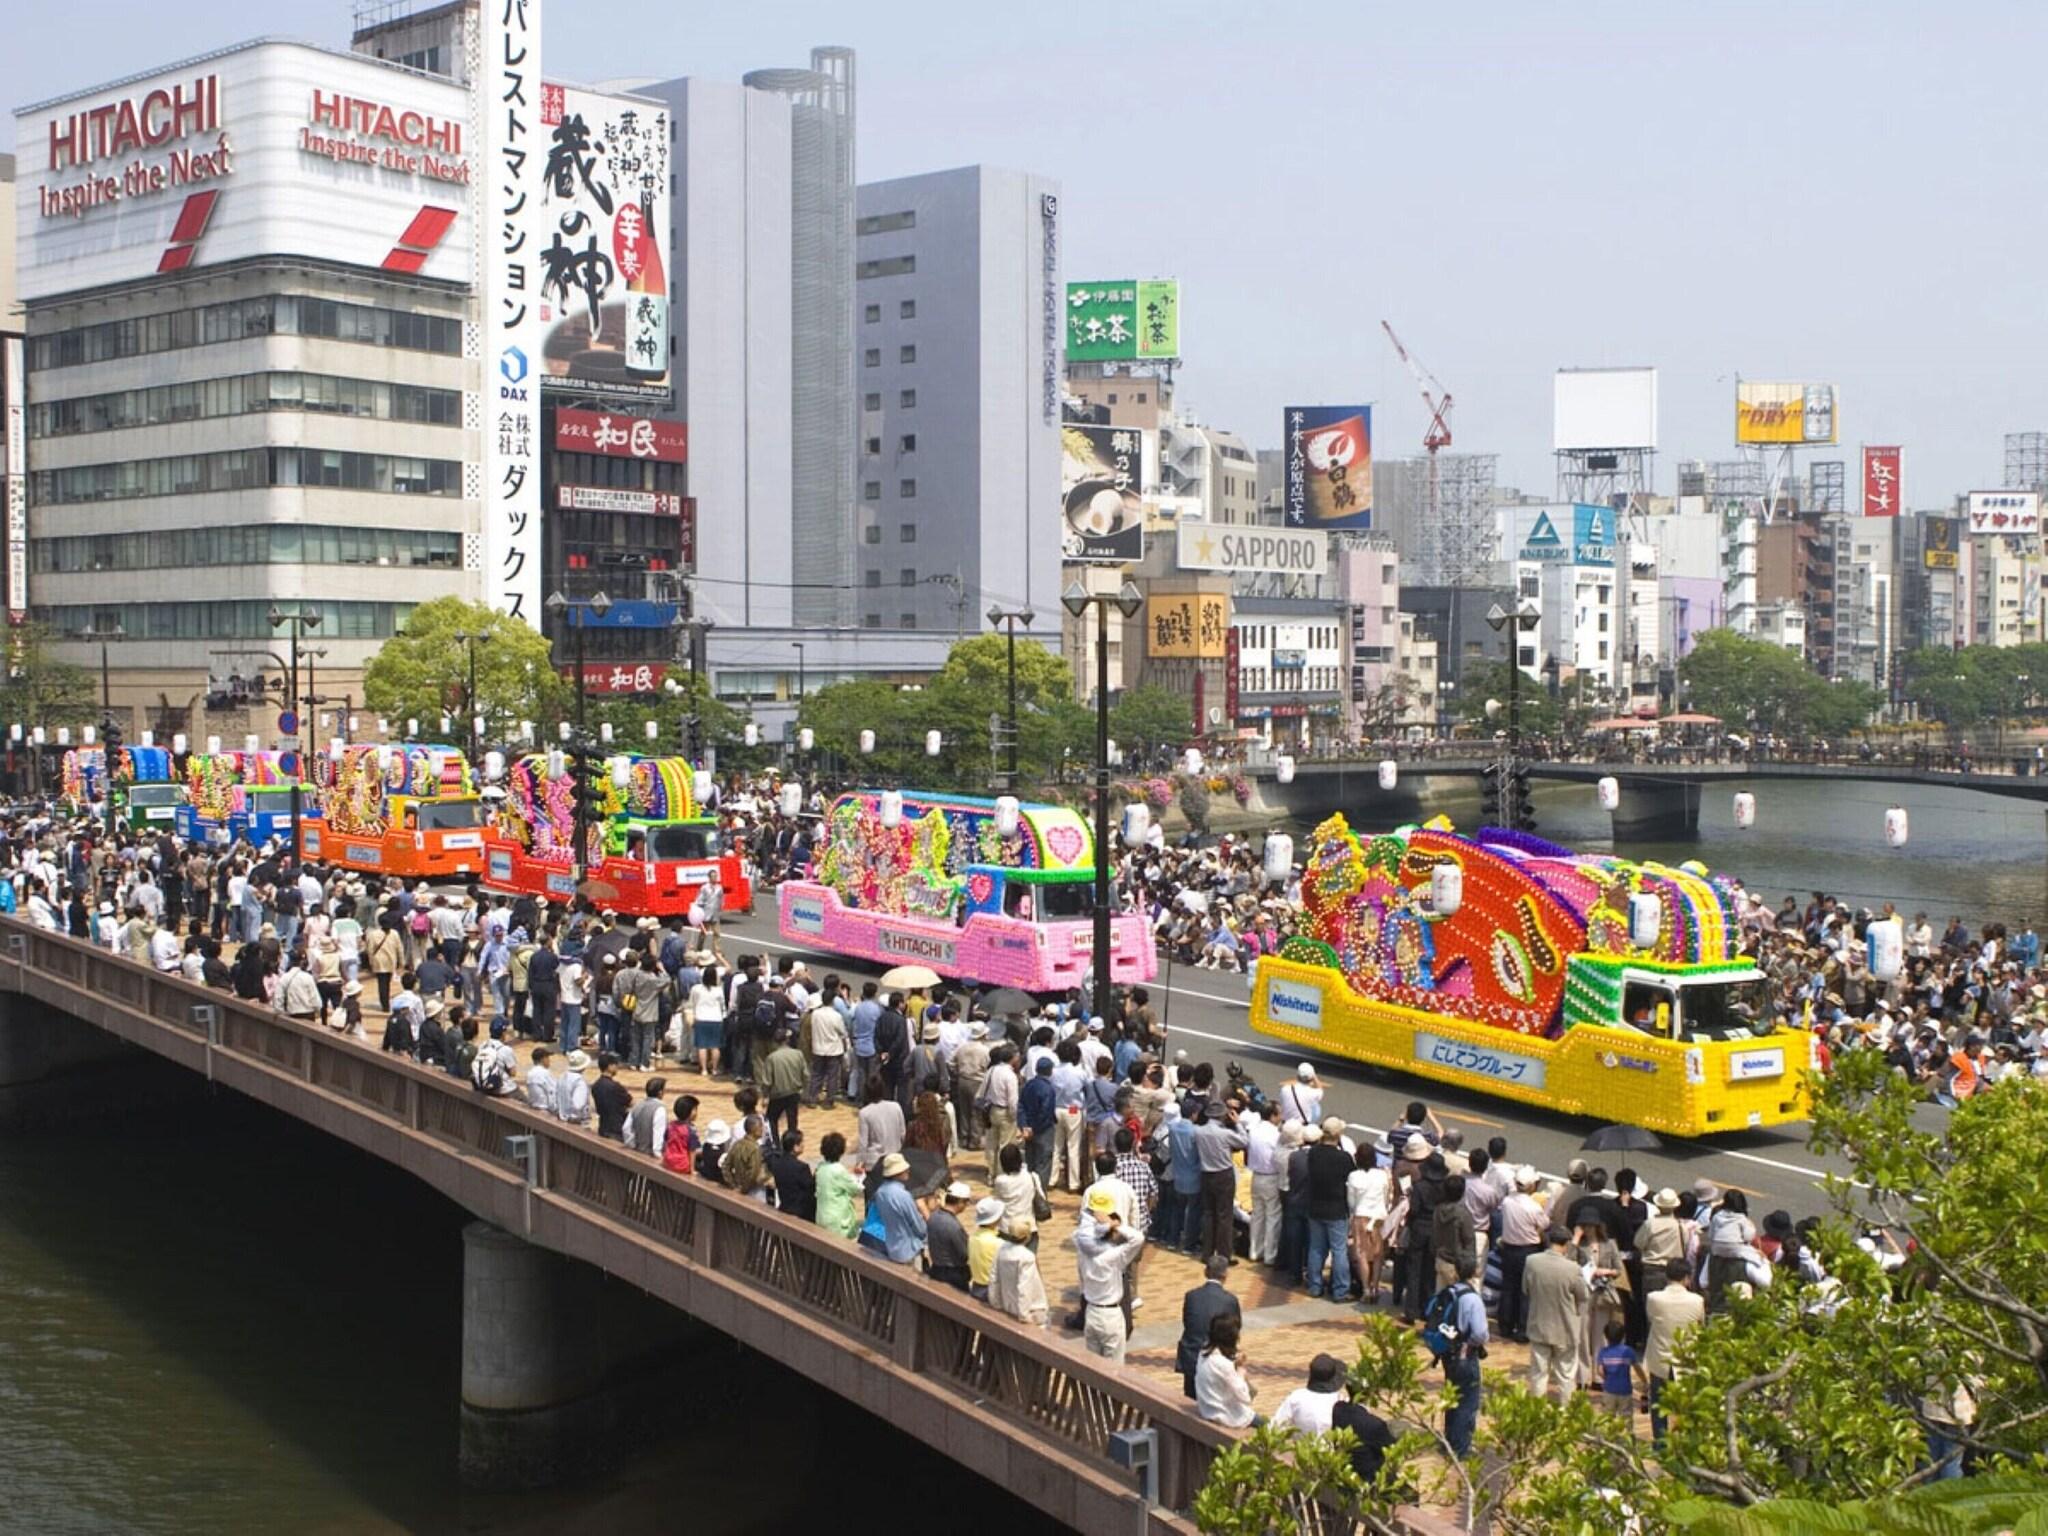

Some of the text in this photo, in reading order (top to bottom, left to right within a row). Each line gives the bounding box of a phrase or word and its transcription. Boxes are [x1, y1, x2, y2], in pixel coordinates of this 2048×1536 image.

[50, 75, 219, 170] HITACHI
[314, 89, 461, 154] HITACHI
[39, 131, 231, 217] Inspire the Next
[301, 127, 470, 185] Inspire the Next
[502, 0, 526, 328] パレストマンション
[540, 113, 614, 335] 蔵の神
[1086, 314, 1134, 344] お茶
[1146, 302, 1169, 345] お茶
[501, 387, 528, 401] DAX
[593, 416, 658, 456] 和民
[503, 465, 527, 621] ダックス
[1221, 535, 1317, 569] SAPPORO
[609, 665, 654, 691] 和民
[893, 936, 942, 958] HITACHI
[1271, 993, 1320, 1014] Nishitetsu
[1432, 1044, 1527, 1080] にしてつグループ
